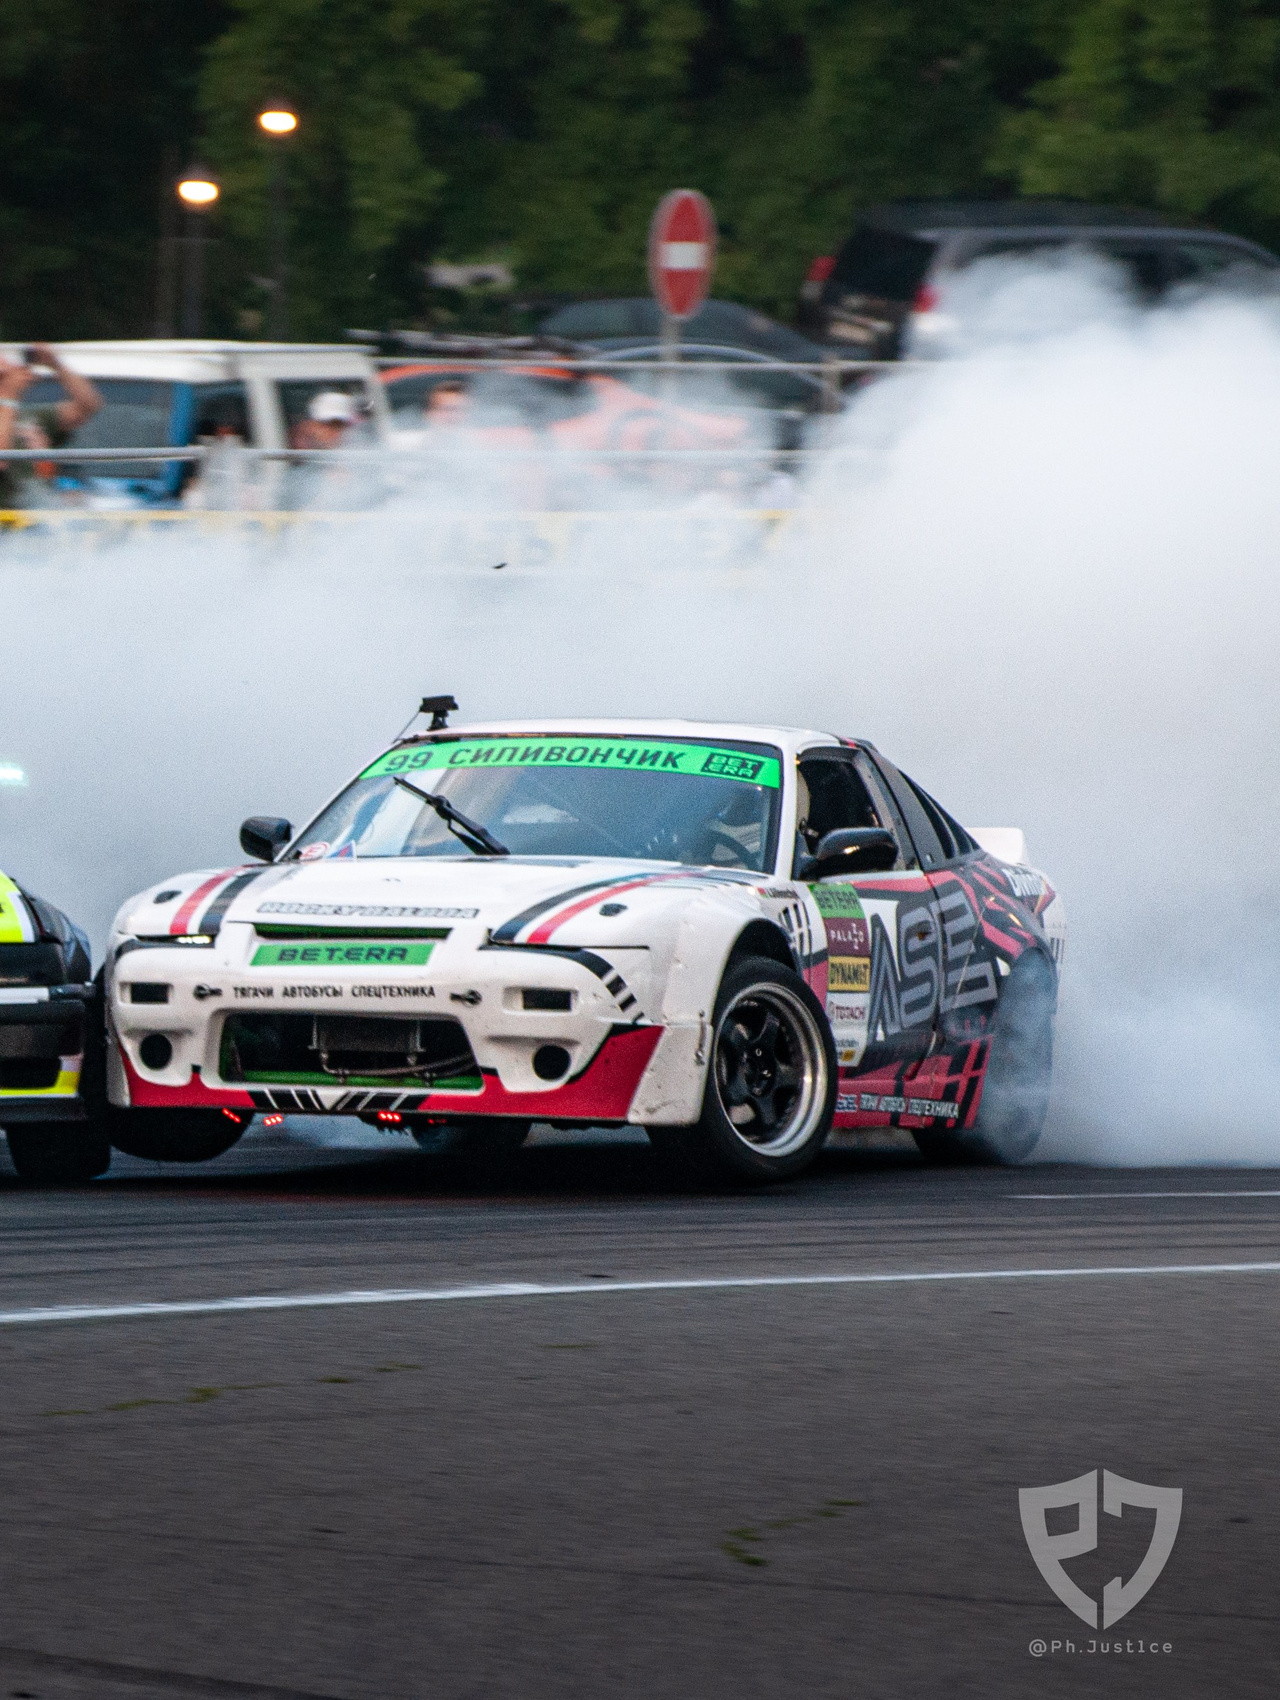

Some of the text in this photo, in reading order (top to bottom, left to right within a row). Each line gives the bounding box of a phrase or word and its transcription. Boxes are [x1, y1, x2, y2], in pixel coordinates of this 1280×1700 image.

[386, 746, 689, 772] 99 СИЛИВОНЧИК
[277, 947, 409, 962] BET.ERA
[233, 984, 436, 1000] ТЯГАЧИ АВТОБУСЫ СПЕЦТЕХНИКА
